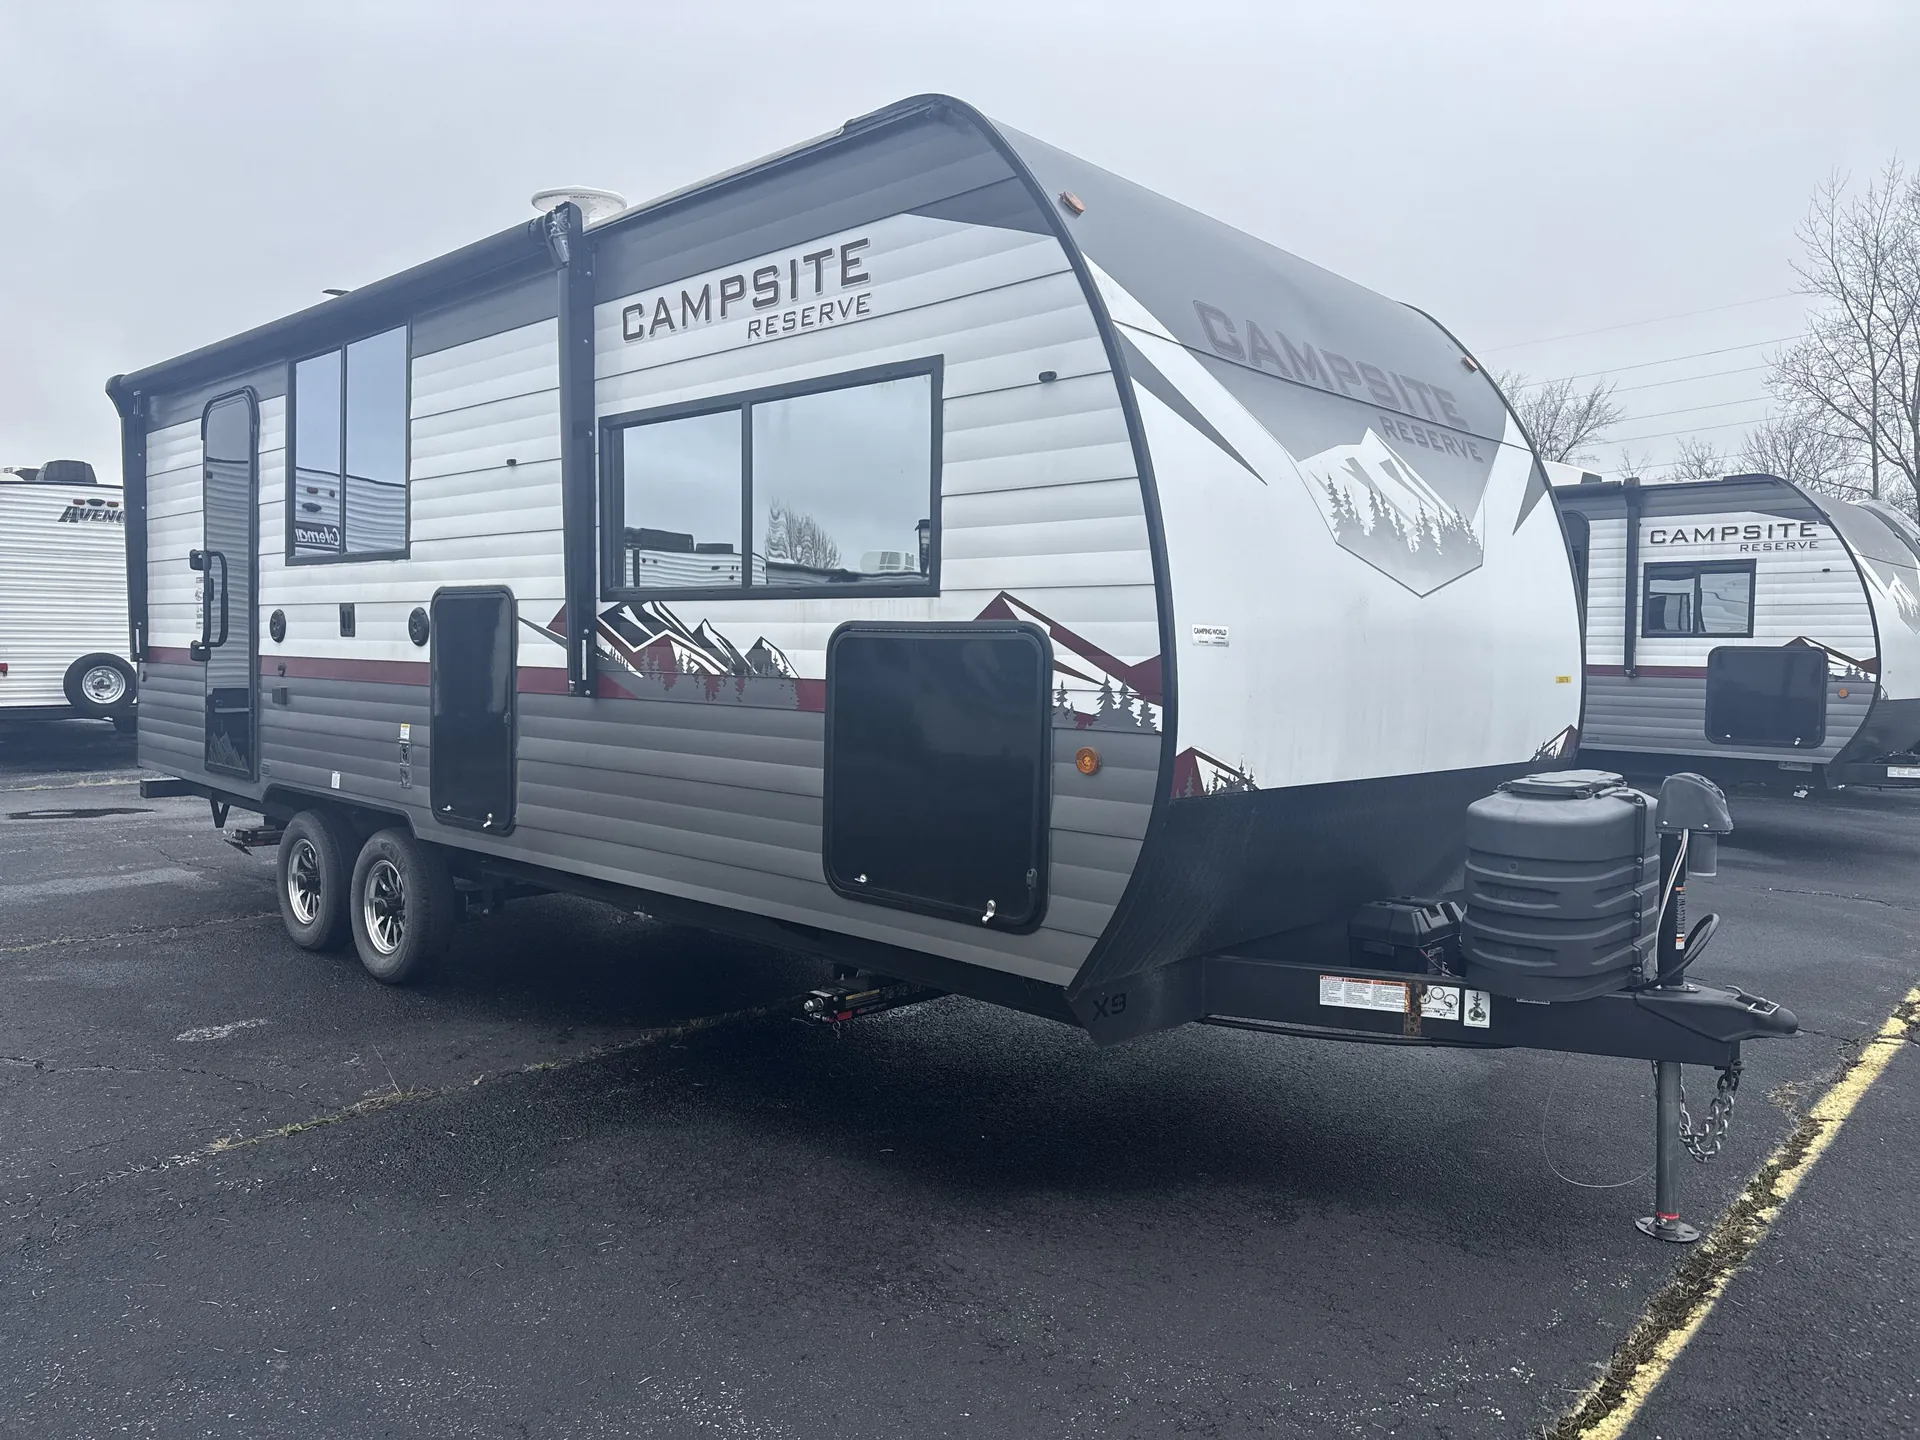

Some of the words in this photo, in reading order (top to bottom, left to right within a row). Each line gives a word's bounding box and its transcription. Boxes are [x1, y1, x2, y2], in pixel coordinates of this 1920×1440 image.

[622, 237, 870, 342] CAMPSITE
[747, 293, 872, 339] RESERVE
[1193, 299, 1469, 431] CAMPSITE
[1378, 415, 1484, 463] RESERVE
[1650, 521, 1817, 544] CAMPSITE
[1740, 541, 1818, 552] RESERVE
[1194, 627, 1212, 635] CAMPING
[1092, 992, 1127, 1021] X9
